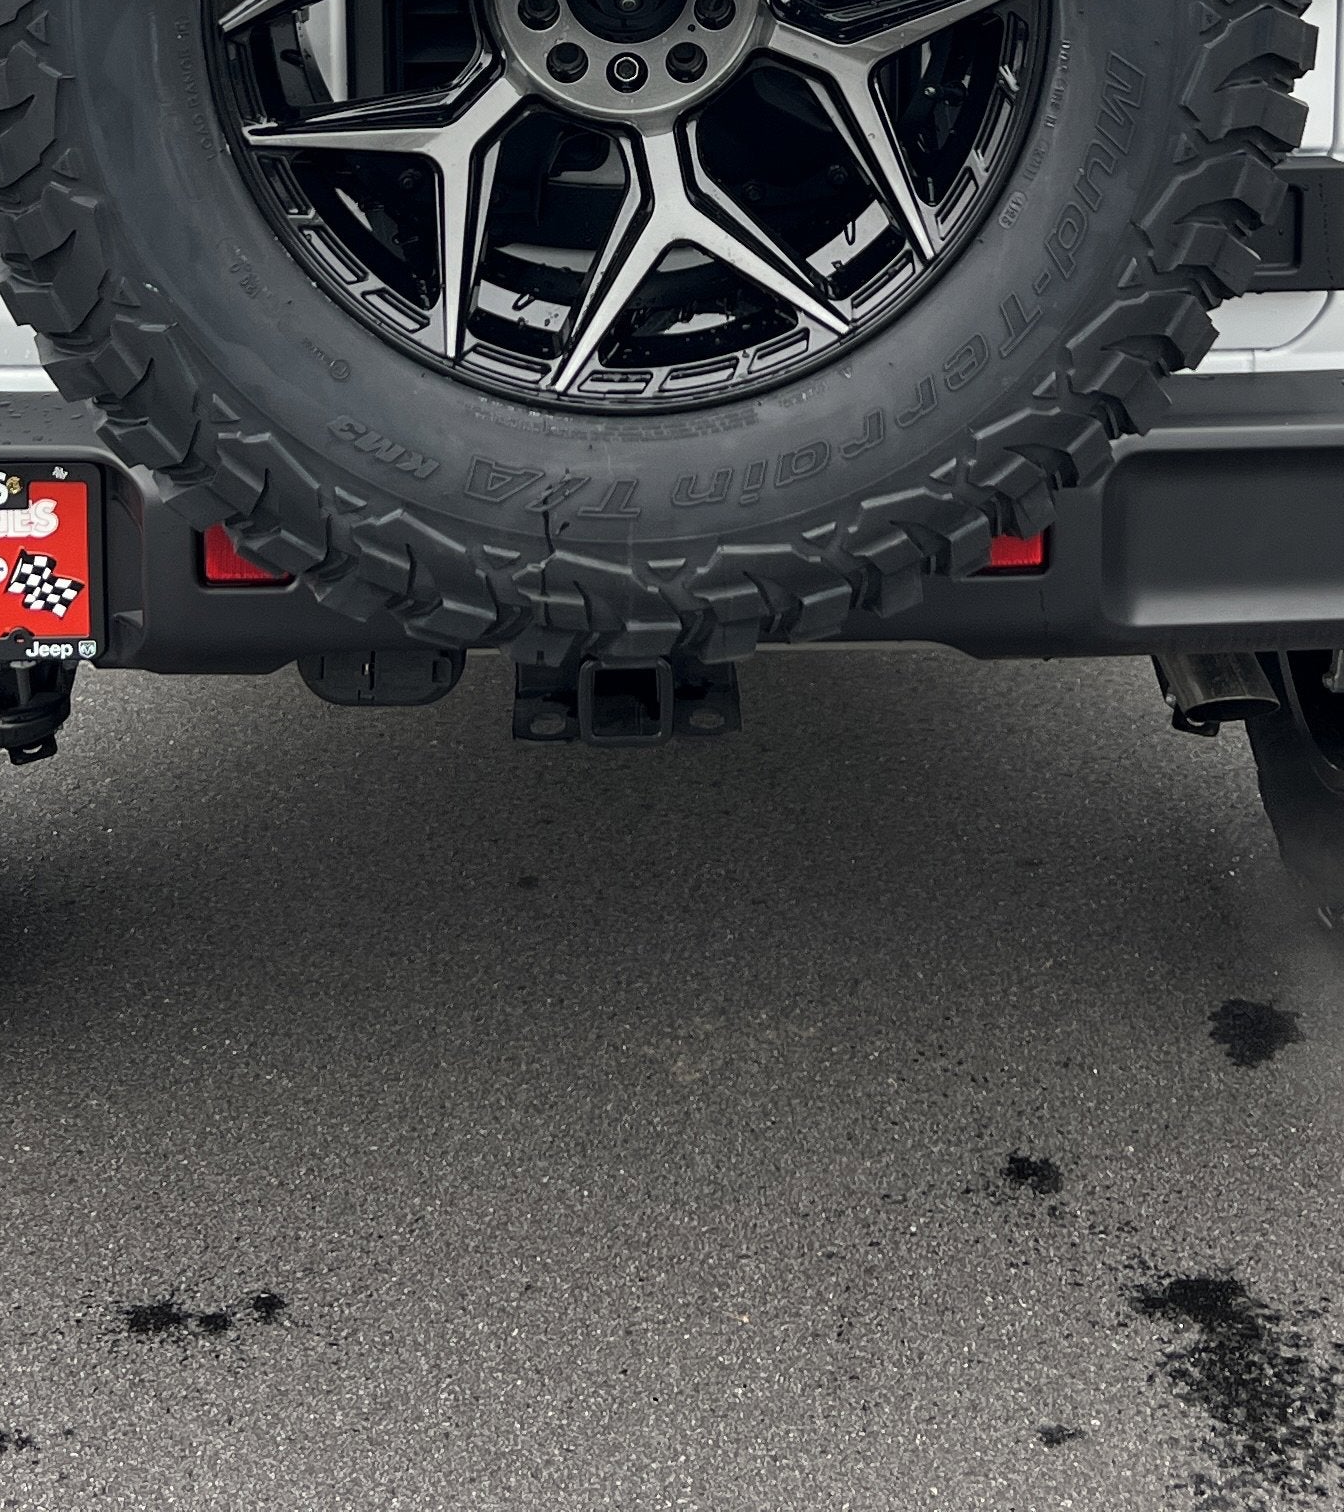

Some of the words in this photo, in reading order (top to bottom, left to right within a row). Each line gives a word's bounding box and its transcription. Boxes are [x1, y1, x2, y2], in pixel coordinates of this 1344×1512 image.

[668, 49, 1146, 510] Mud-Terrain
[326, 414, 440, 479] KM3
[464, 455, 642, 518] T/A
[25, 641, 74, 660] Jeep
